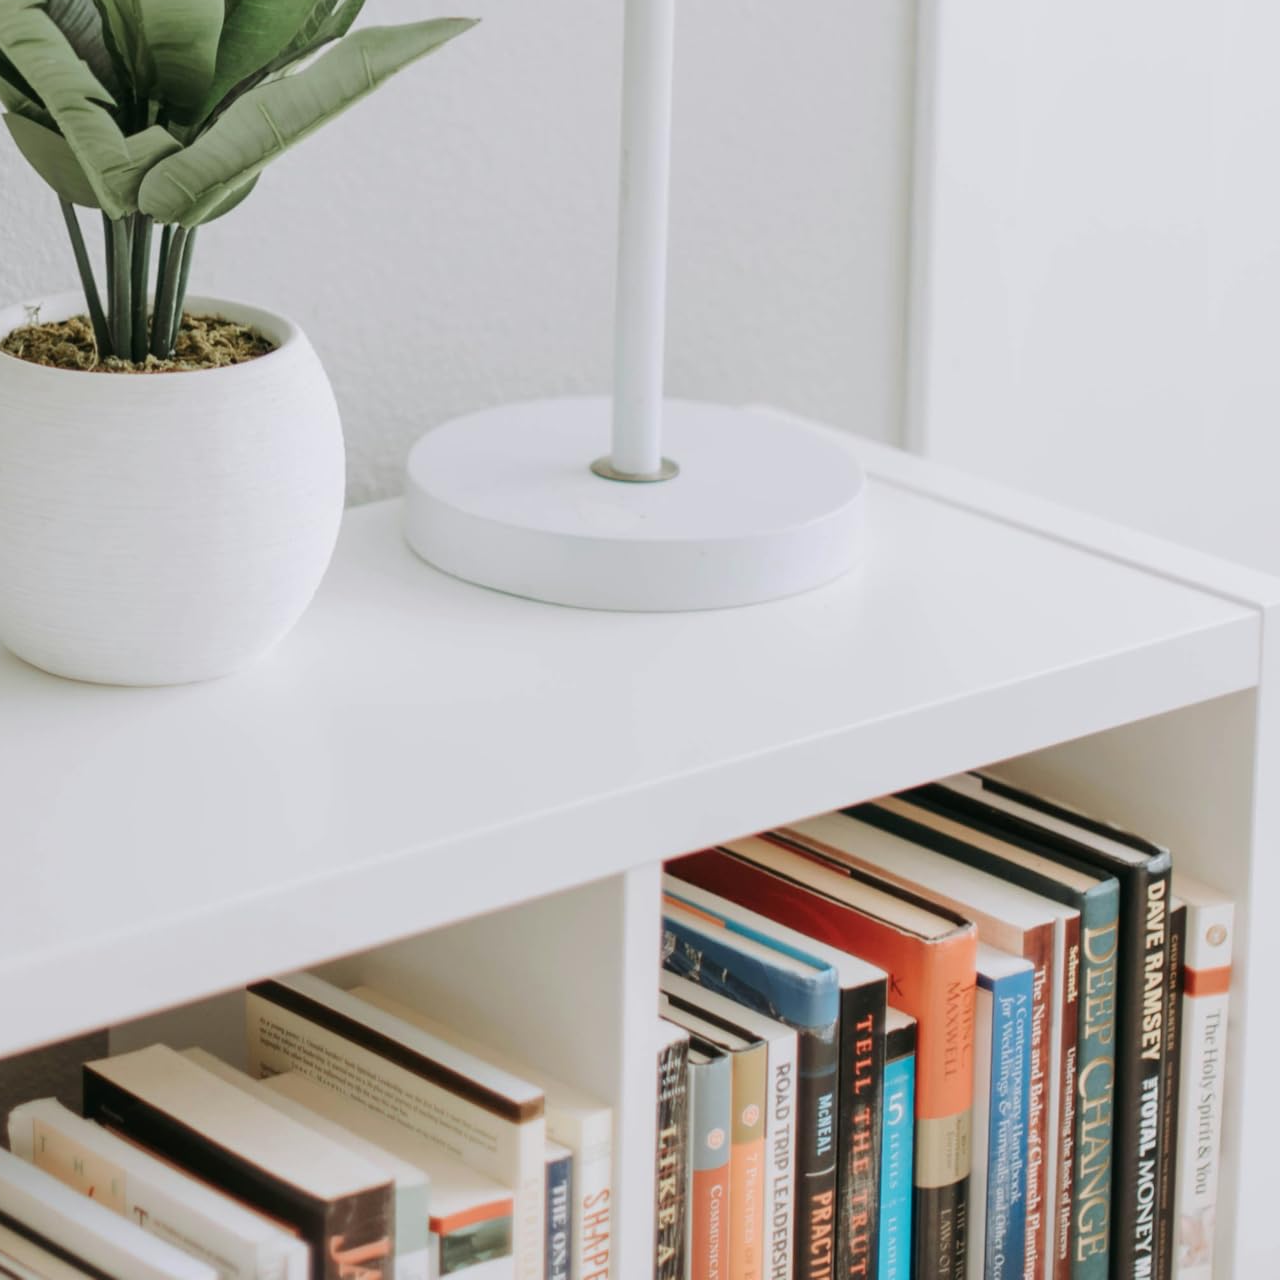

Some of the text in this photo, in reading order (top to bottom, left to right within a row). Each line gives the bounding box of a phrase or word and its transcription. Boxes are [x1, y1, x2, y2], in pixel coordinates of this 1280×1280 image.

[1033, 964, 1047, 1001] The
[1067, 943, 1080, 1003] Schenck
[1141, 879, 1166, 1060] DAVE RAMSEY
[854, 1014, 874, 1095] TELL
[945, 981, 960, 1082] MAXWELL
[1031, 1004, 1045, 1047] Nuts
[996, 1021, 1014, 1098] Weddings
[1010, 1005, 1027, 1120] Contemporary
[1030, 1049, 1044, 1079] and
[1077, 916, 1120, 1262] DEEP CHANGE
[774, 1062, 791, 1120] ROAD
[888, 1091, 905, 1126] 5
[1028, 1083, 1043, 1126] Bolts
[1063, 1046, 1077, 1136] Understanding
[1194, 1008, 1221, 1195] The Holy Spirit & You
[773, 1124, 790, 1171] TRIP
[817, 1093, 833, 1156] McNEAL
[852, 1107, 872, 1175] THE
[1027, 1129, 1041, 1146] of
[1063, 1138, 1074, 1157] the
[1139, 1087, 1158, 1157] TOTAL
[551, 1179, 568, 1229] THE
[659, 1120, 677, 1229] LIKE
[1026, 1148, 1042, 1210] Church
[1061, 1159, 1073, 1192] Book
[1059, 1207, 1071, 1260] Hebrews
[1134, 1159, 1156, 1252] MONEY
[658, 1243, 675, 1267] A
[939, 1208, 953, 1274] LAWS OF
[992, 1253, 1005, 1280] Occ
